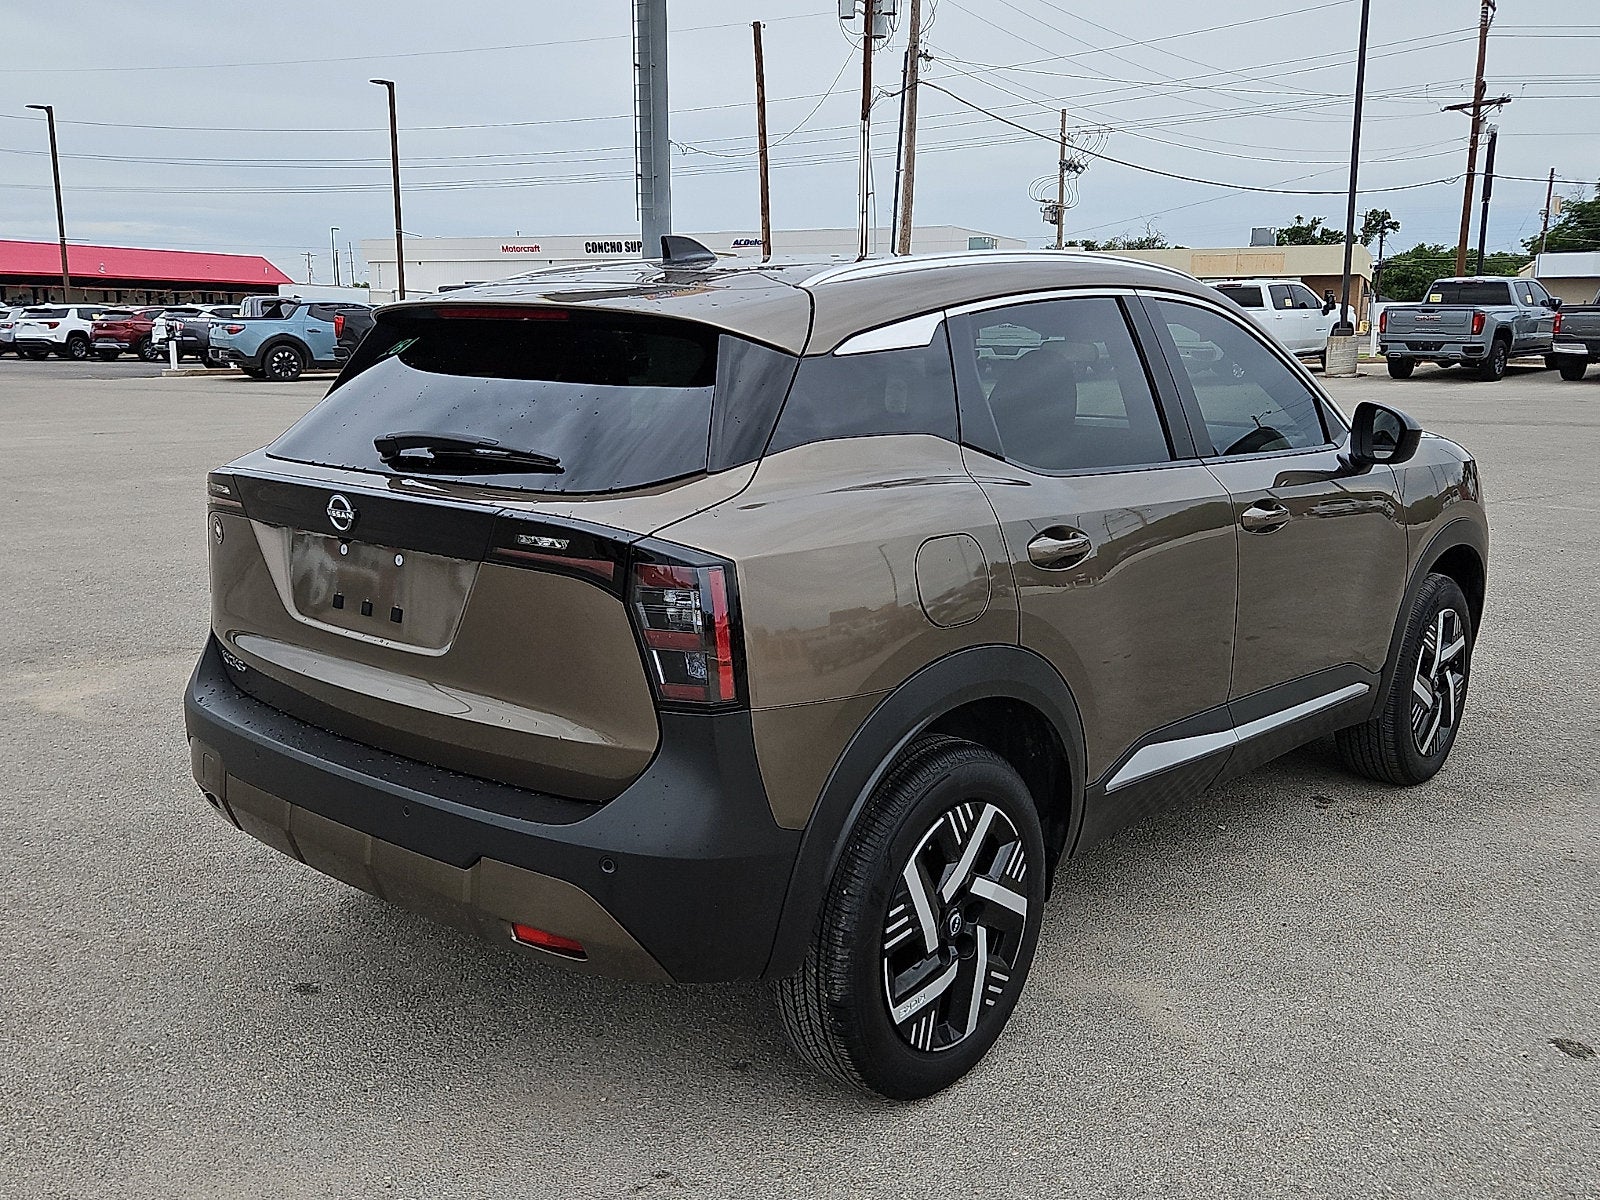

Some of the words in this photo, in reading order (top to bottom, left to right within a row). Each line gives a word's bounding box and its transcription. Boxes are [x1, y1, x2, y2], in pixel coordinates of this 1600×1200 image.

[732, 238, 765, 246] ACDelc
[501, 244, 541, 253] Motorcraft
[584, 241, 623, 254] CONCHO
